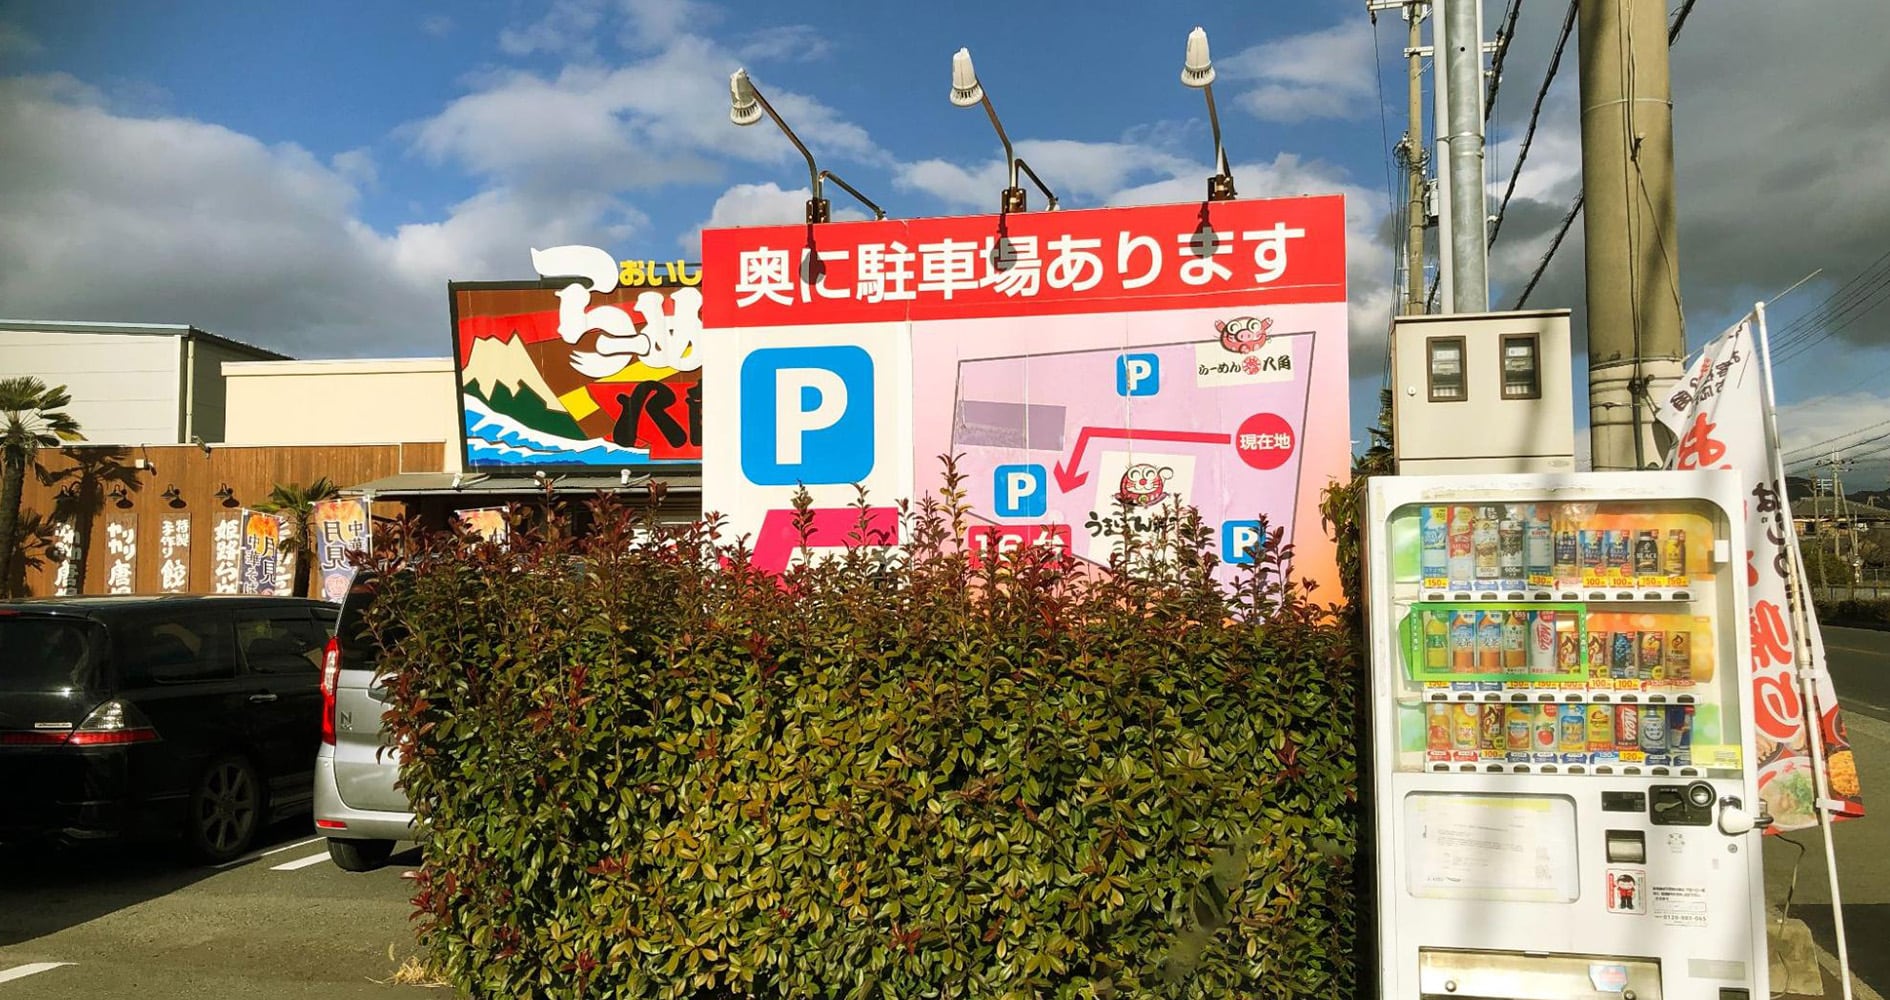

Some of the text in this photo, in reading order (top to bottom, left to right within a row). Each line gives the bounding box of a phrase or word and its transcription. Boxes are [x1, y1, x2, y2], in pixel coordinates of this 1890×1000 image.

[735, 222, 1306, 308] 奥に駐車場あります
[1126, 360, 1152, 393] P
[1263, 354, 1292, 371] 八角
[613, 379, 702, 448] 八
[775, 366, 849, 466] P
[1240, 433, 1291, 452] 現在地
[1007, 472, 1037, 510] P
[160, 520, 176, 559] 手作り
[1233, 526, 1258, 558] P
[160, 559, 187, 593] 餃
[259, 534, 277, 585] 月見
[1624, 707, 1637, 741] Mets
